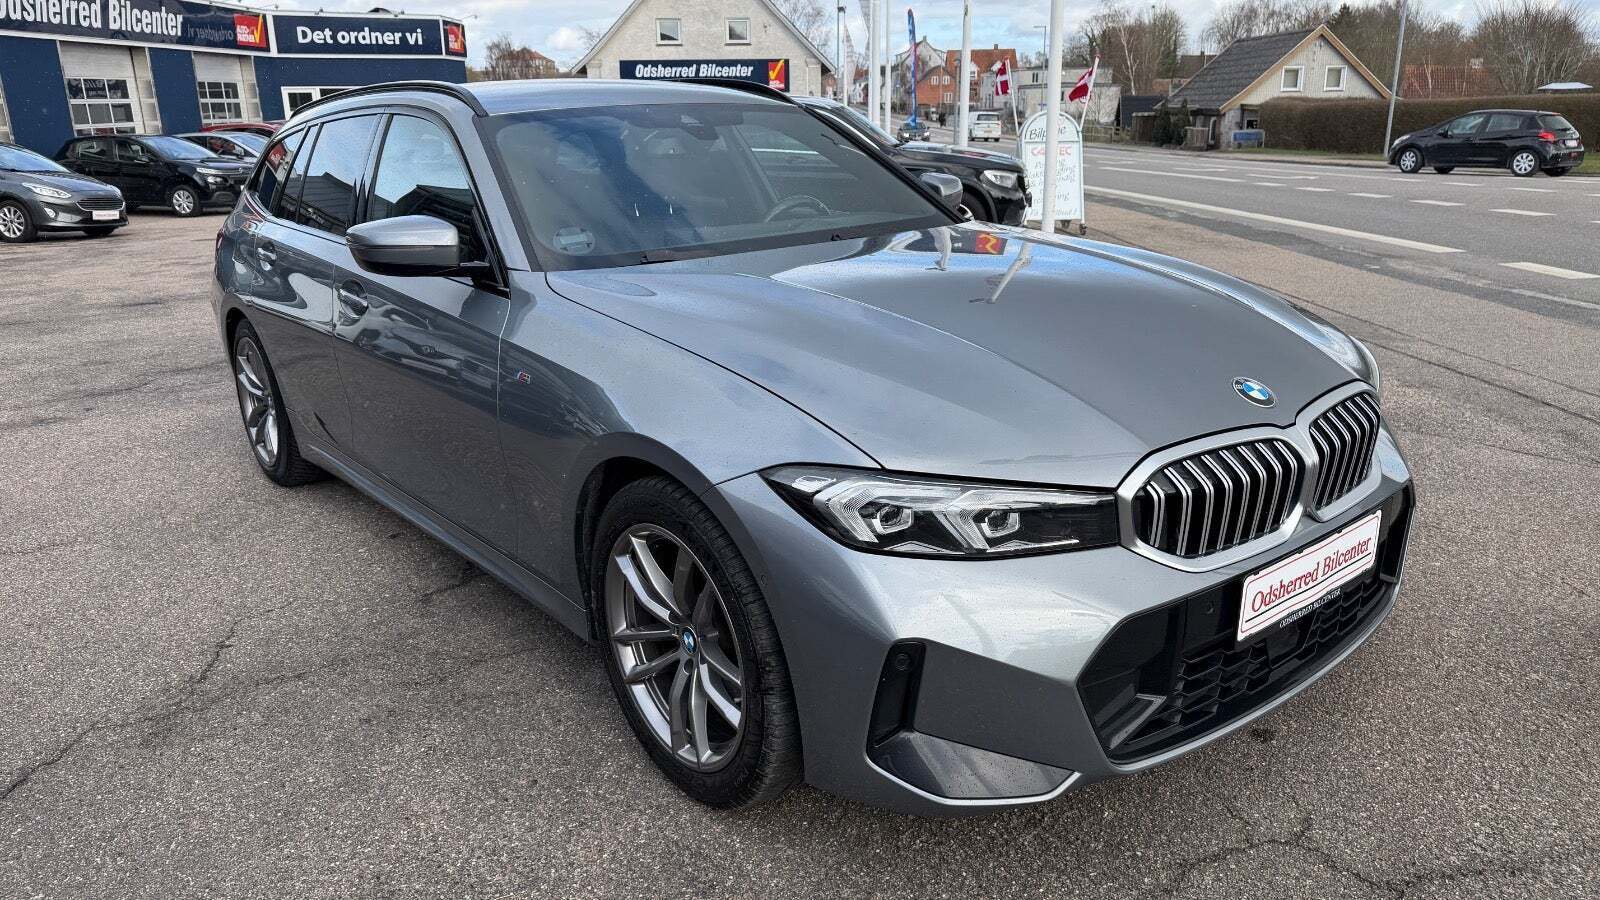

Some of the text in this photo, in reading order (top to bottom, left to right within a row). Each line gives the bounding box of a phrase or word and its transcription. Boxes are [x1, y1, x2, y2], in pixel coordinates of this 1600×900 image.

[109, 0, 183, 36] Bilcenter
[296, 26, 423, 45] Det ordner vi
[635, 63, 753, 78] Odsherred Bilcenter
[1031, 147, 1072, 156] CAEC
[1252, 537, 1372, 612] Odsherred Bilcenter
